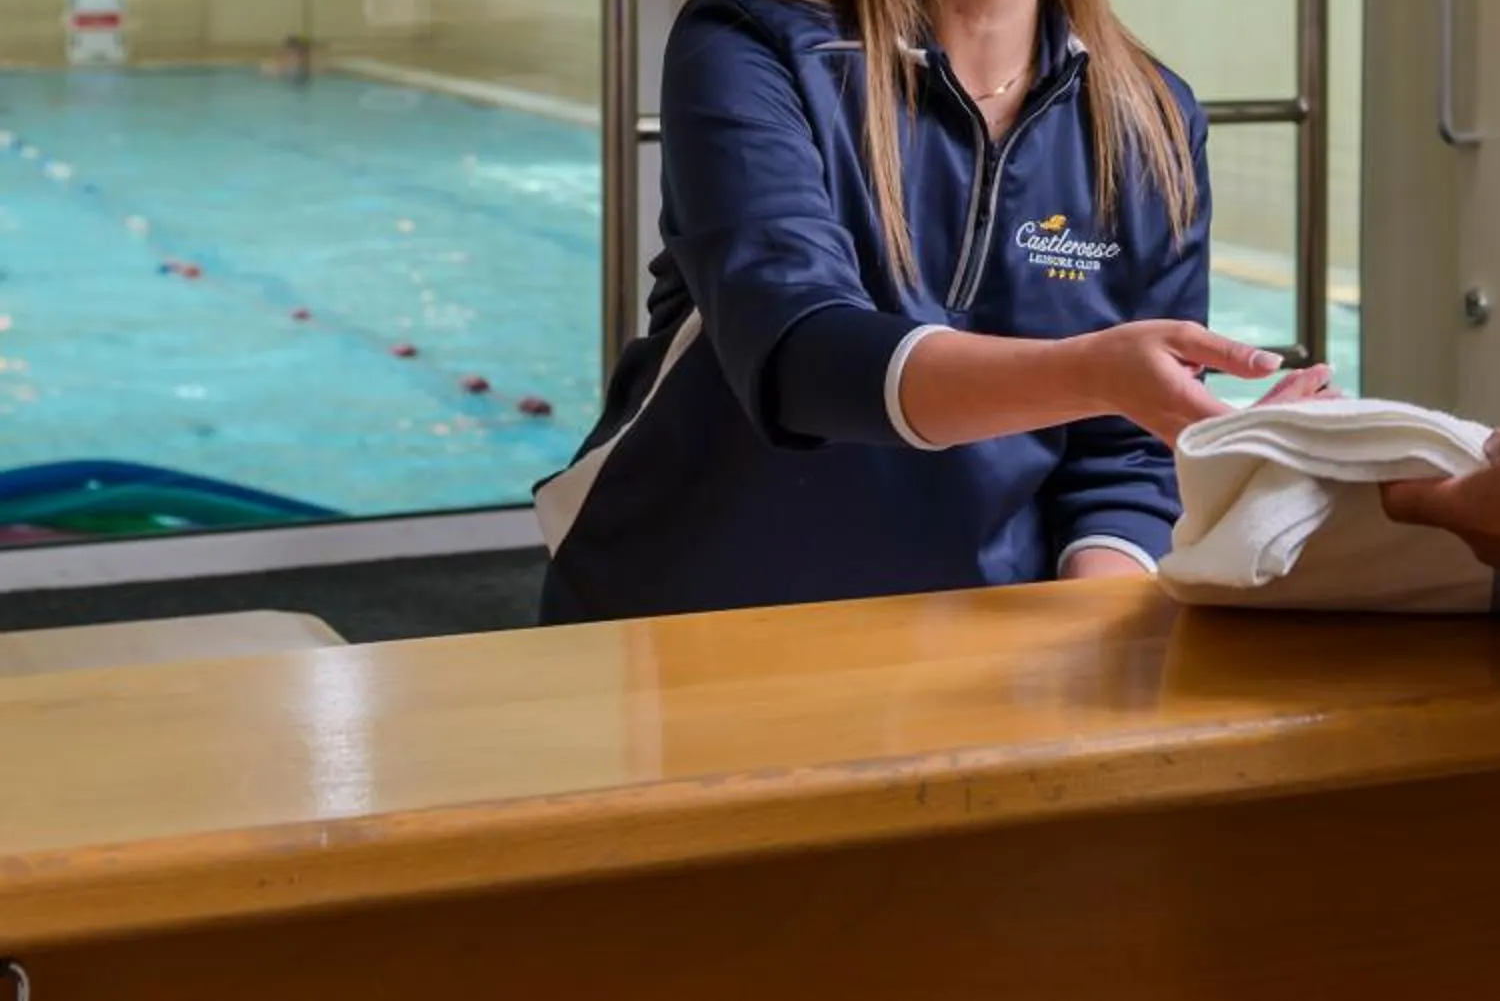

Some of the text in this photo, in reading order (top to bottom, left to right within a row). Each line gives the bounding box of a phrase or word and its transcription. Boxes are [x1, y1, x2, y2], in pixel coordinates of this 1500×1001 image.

[1016, 222, 1120, 258] Castlerosse
[1029, 253, 1101, 270] LEISURE CLUB
